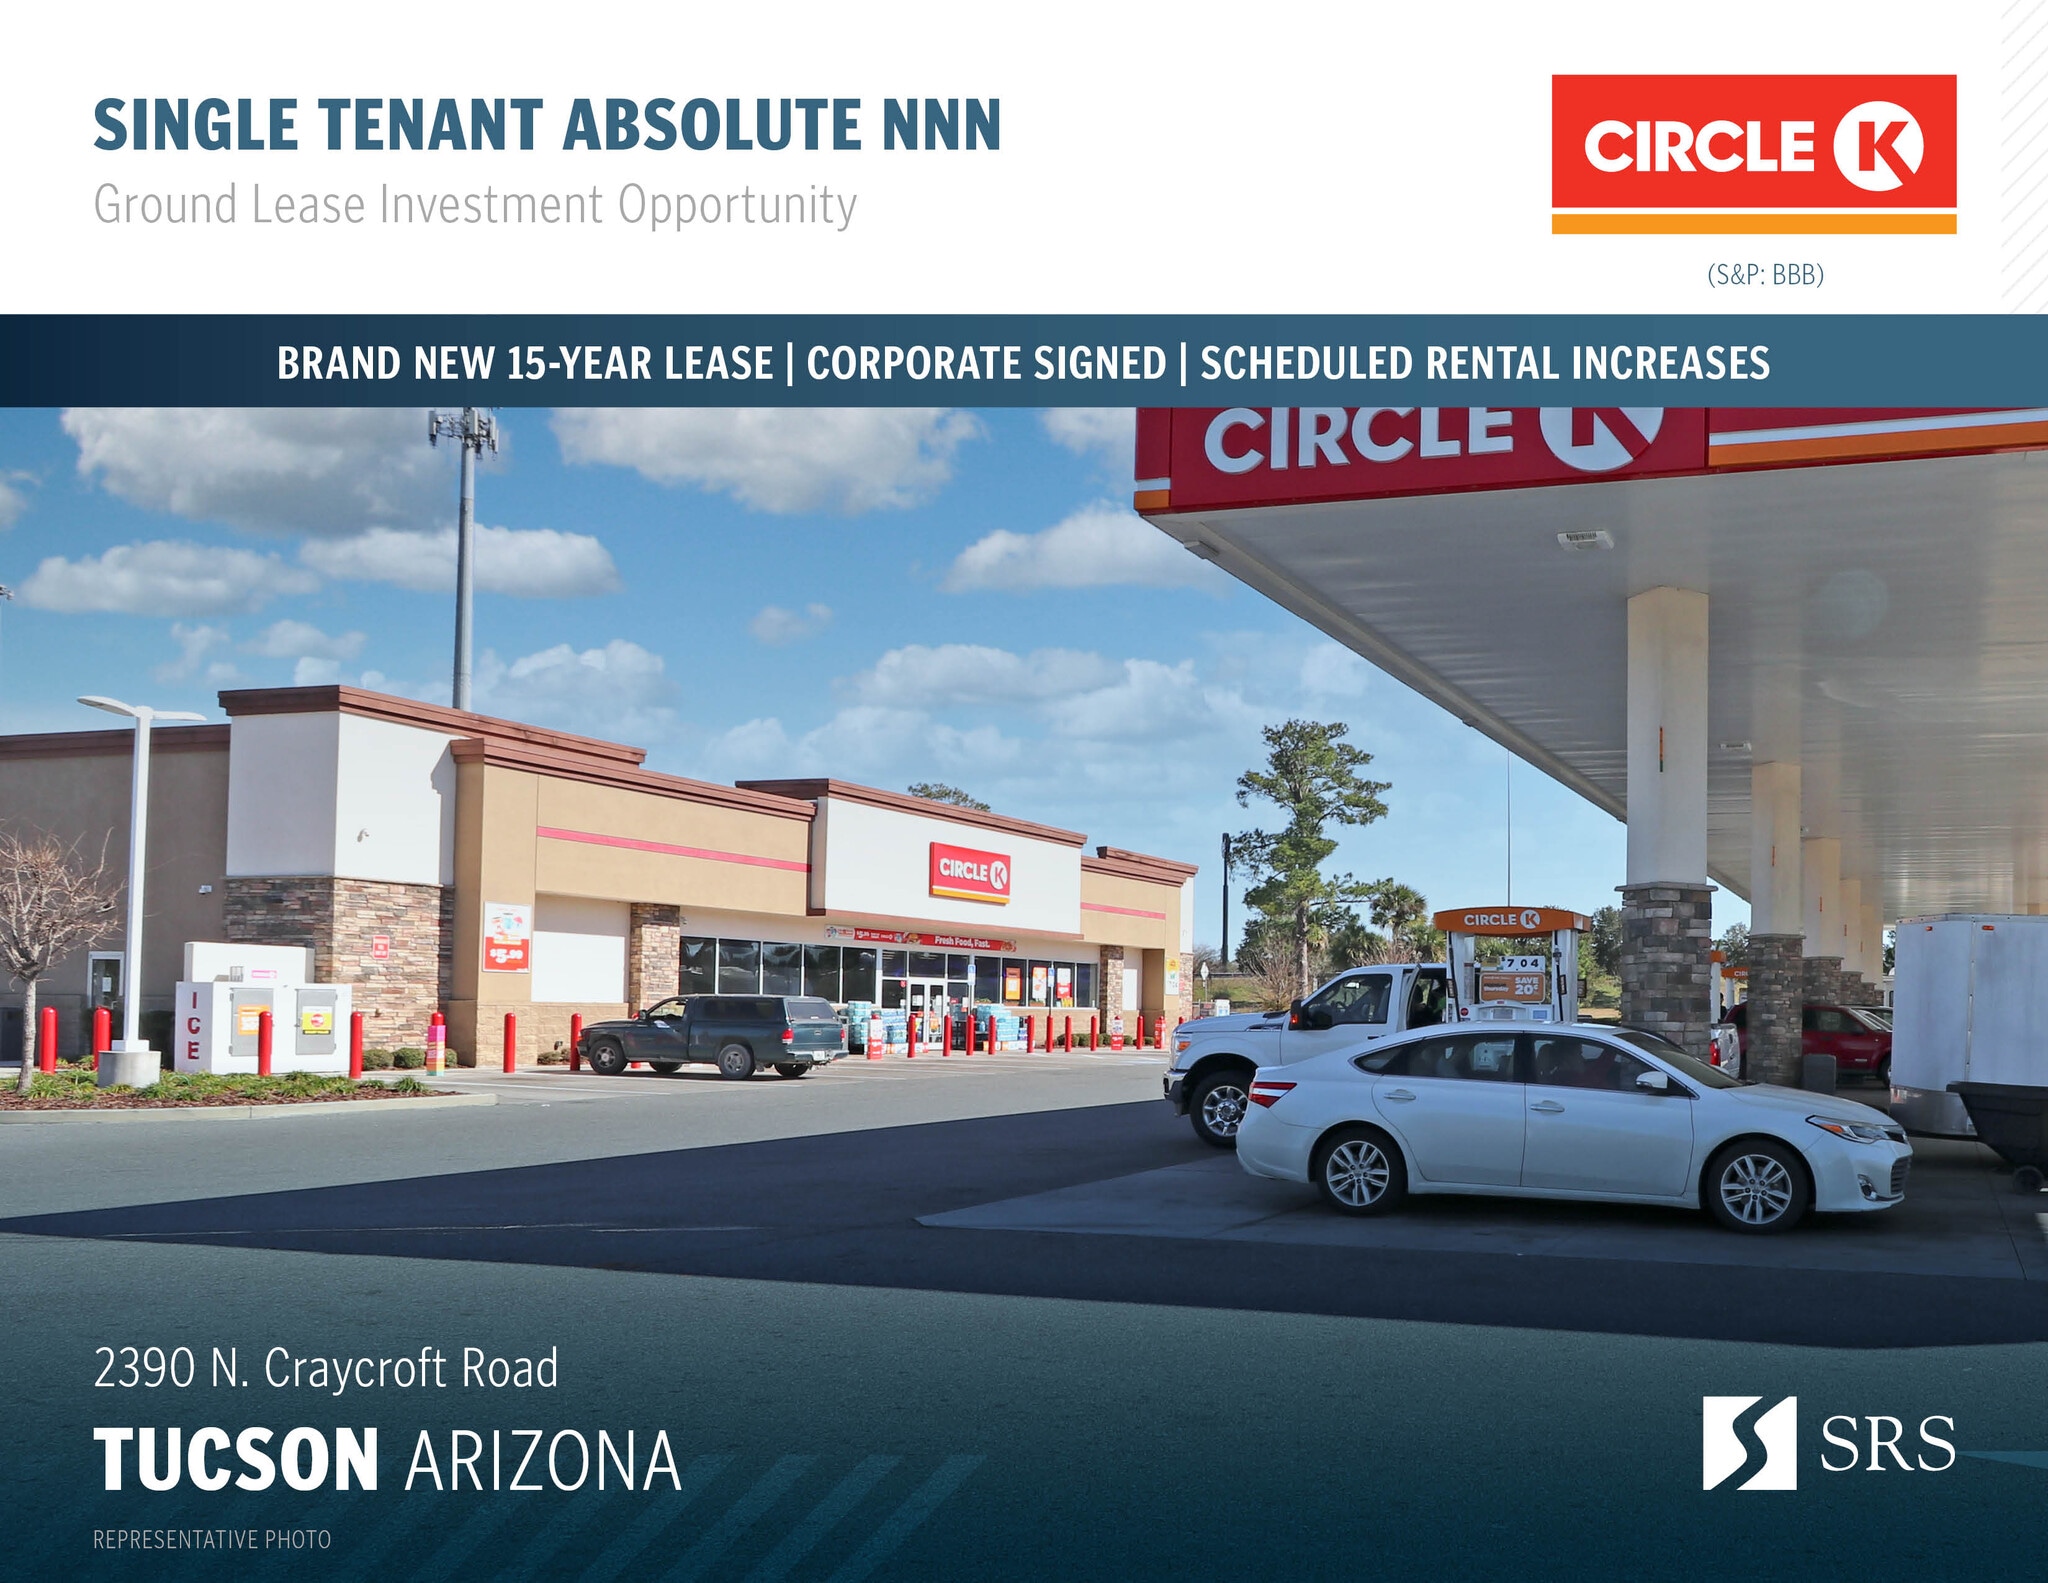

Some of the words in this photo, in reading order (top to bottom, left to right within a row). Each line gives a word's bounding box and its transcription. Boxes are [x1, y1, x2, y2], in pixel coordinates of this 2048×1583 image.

[1204, 407, 1514, 474] CIRCLE
[940, 858, 988, 882] CIRCLE
[992, 863, 1007, 889] K
[1464, 914, 1517, 926] CIRCLE
[1522, 911, 1539, 927] K
[935, 936, 954, 945] Fresh
[955, 937, 974, 948] Food,
[974, 939, 990, 948] Fast.
[186, 991, 201, 1060] ICE
